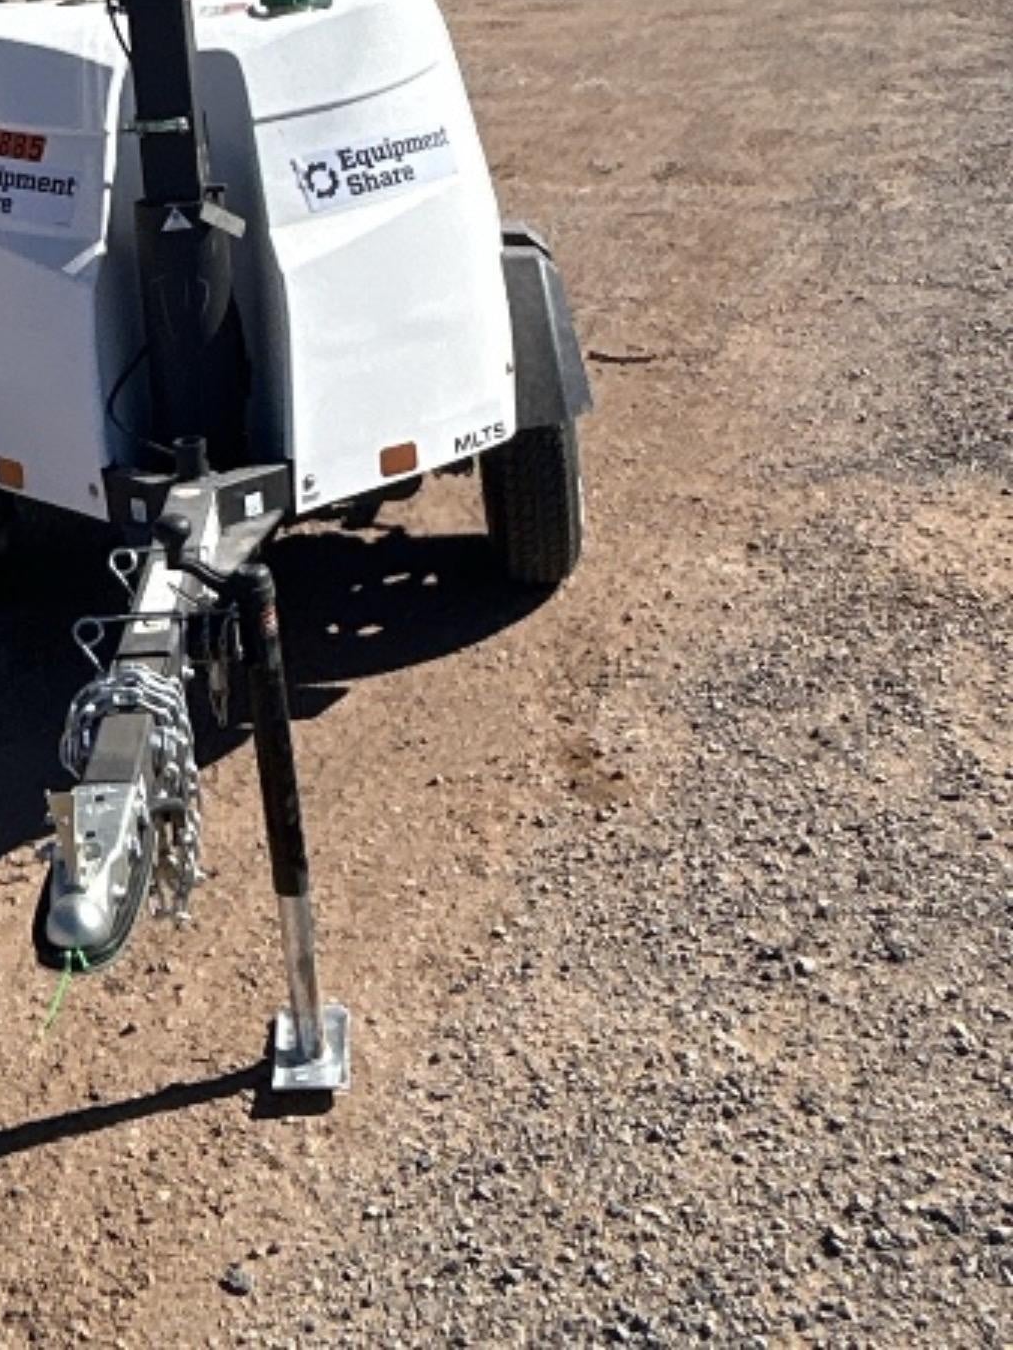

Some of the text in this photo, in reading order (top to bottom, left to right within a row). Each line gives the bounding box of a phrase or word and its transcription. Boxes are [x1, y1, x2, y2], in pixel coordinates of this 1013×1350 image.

[336, 125, 450, 171] Equipment
[346, 165, 415, 196] Share
[454, 420, 506, 453] MLTS
